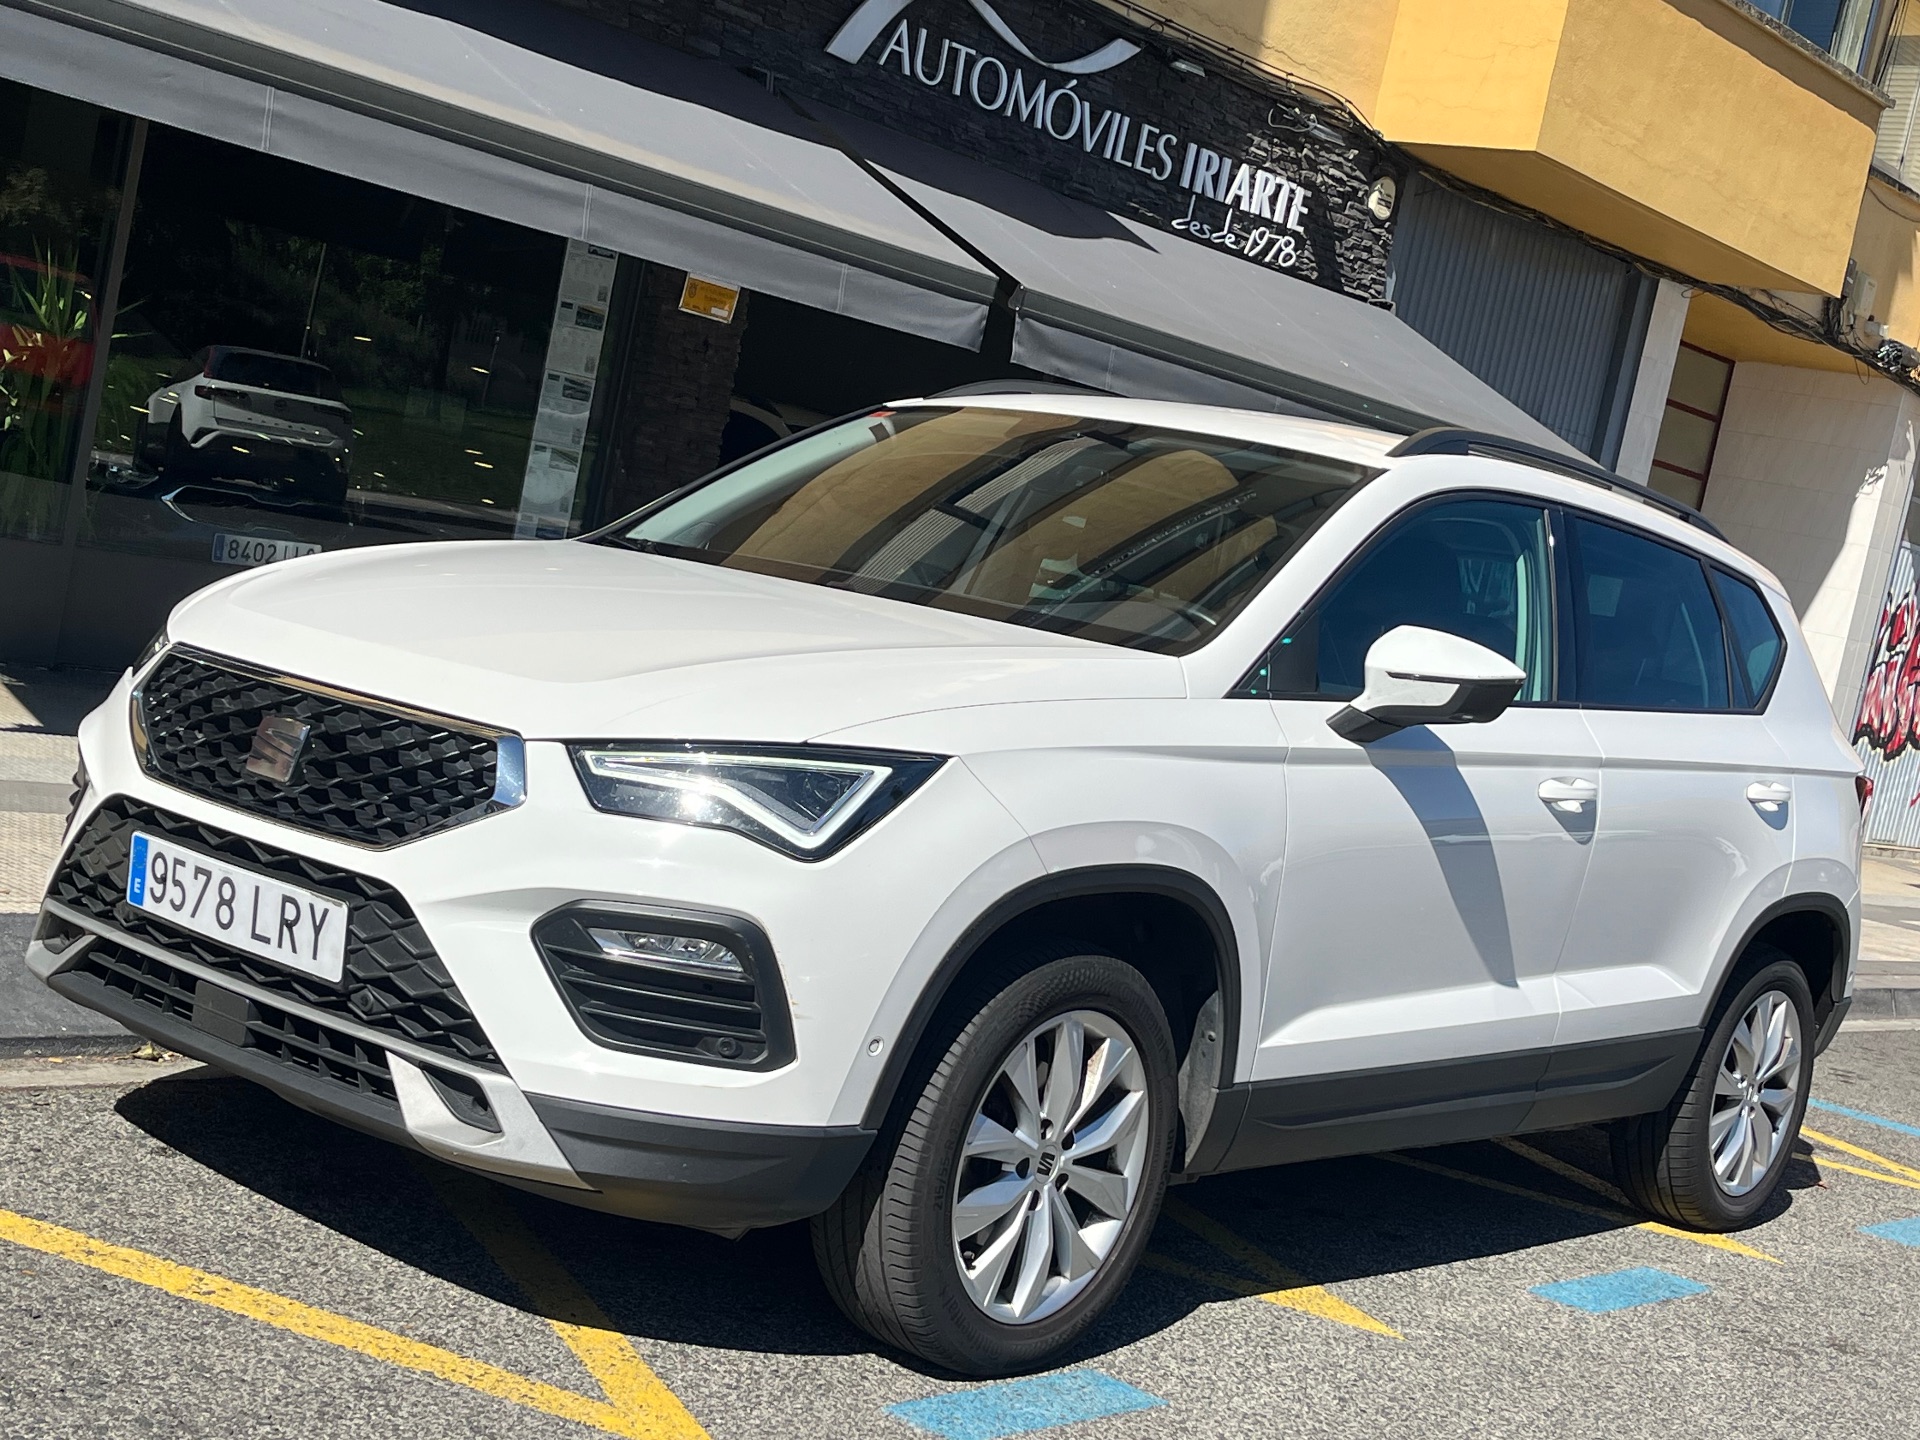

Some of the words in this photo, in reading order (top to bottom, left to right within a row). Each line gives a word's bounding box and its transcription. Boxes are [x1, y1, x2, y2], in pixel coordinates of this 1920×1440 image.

[877, 18, 1177, 181] AUTOMÓVILES
[1179, 141, 1312, 233] IRIARTE
[1171, 194, 1240, 250] desde
[1243, 226, 1297, 267] 1978
[228, 539, 277, 564] 8402
[134, 877, 141, 894] E
[149, 851, 236, 931] 9578
[250, 885, 329, 961] LRY
[932, 1156, 950, 1213] 215/55
